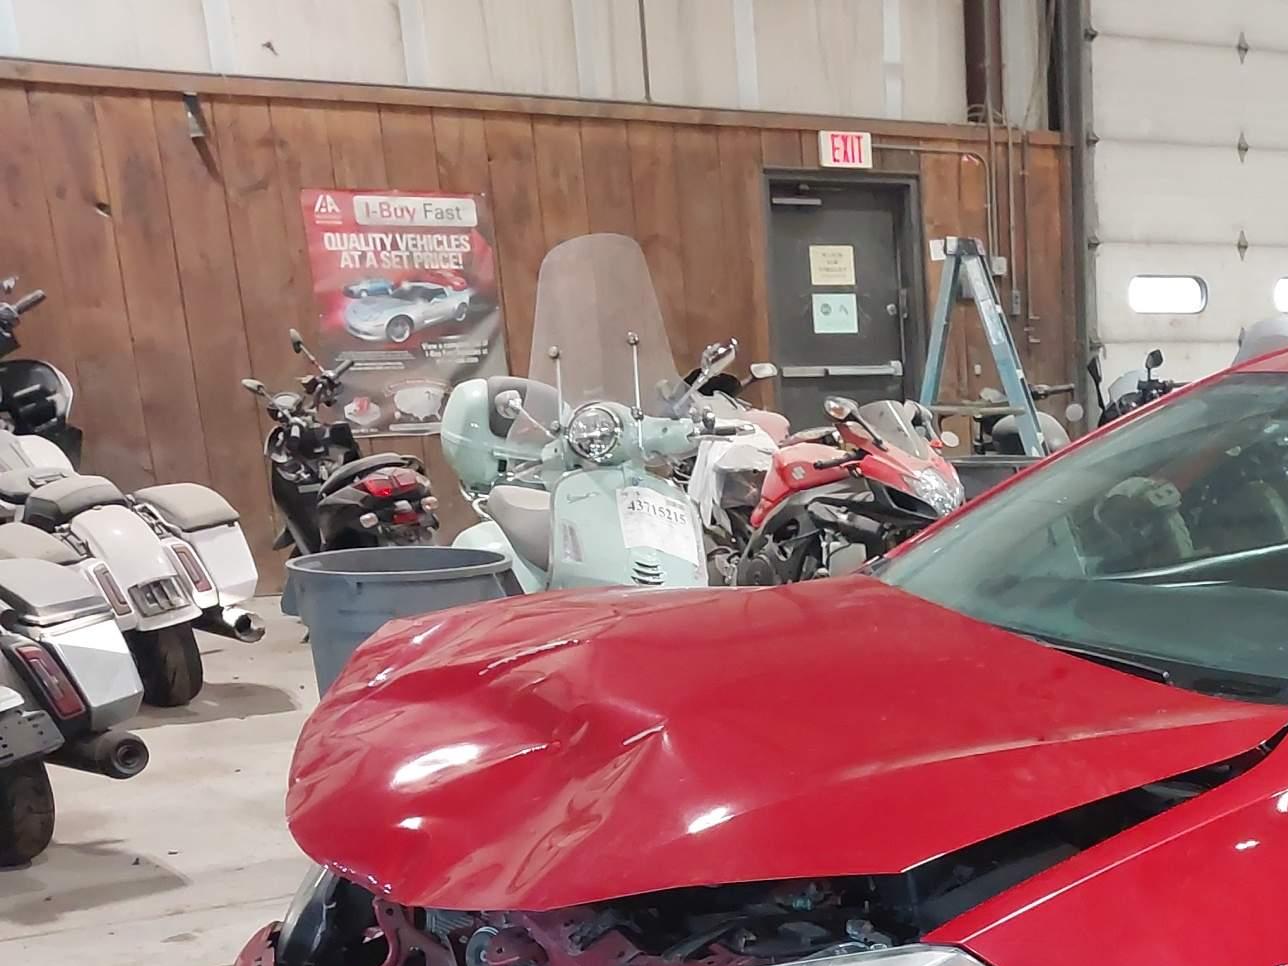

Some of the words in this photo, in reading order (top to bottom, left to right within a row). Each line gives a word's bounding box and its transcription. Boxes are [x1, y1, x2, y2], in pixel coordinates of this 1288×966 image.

[831, 134, 864, 163] EXIT
[365, 201, 417, 222] I-Buy
[423, 203, 462, 221] Fast
[323, 232, 394, 251] QUALITY
[396, 233, 471, 252] VEHICLES
[340, 251, 362, 268] AT
[366, 251, 378, 268] A
[380, 251, 411, 269] SET
[414, 252, 465, 270] PRICE!
[627, 499, 687, 525] 43715215
